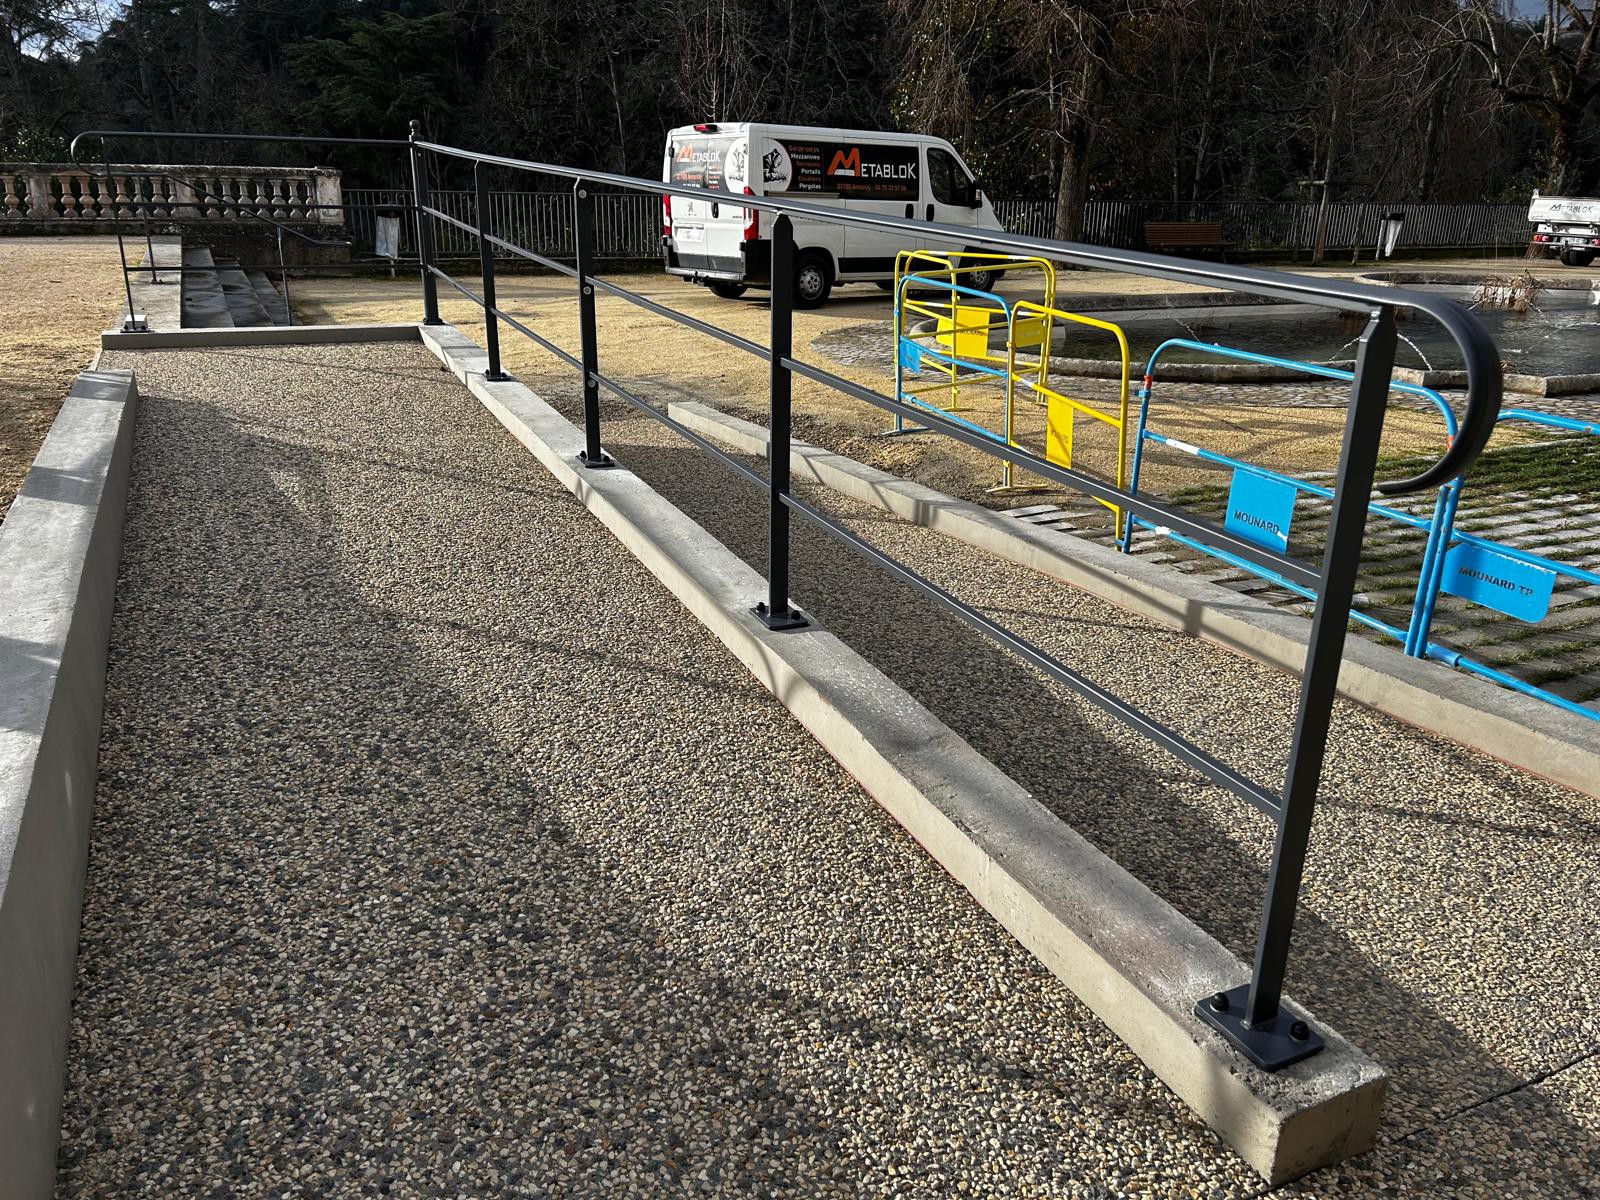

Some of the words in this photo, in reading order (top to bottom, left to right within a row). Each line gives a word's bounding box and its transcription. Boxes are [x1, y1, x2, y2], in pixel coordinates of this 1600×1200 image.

[827, 147, 917, 179] METABLOK
[1234, 510, 1280, 535] MOUNARD
[1459, 567, 1516, 591] MOUNARD
[1519, 585, 1534, 596] TP
